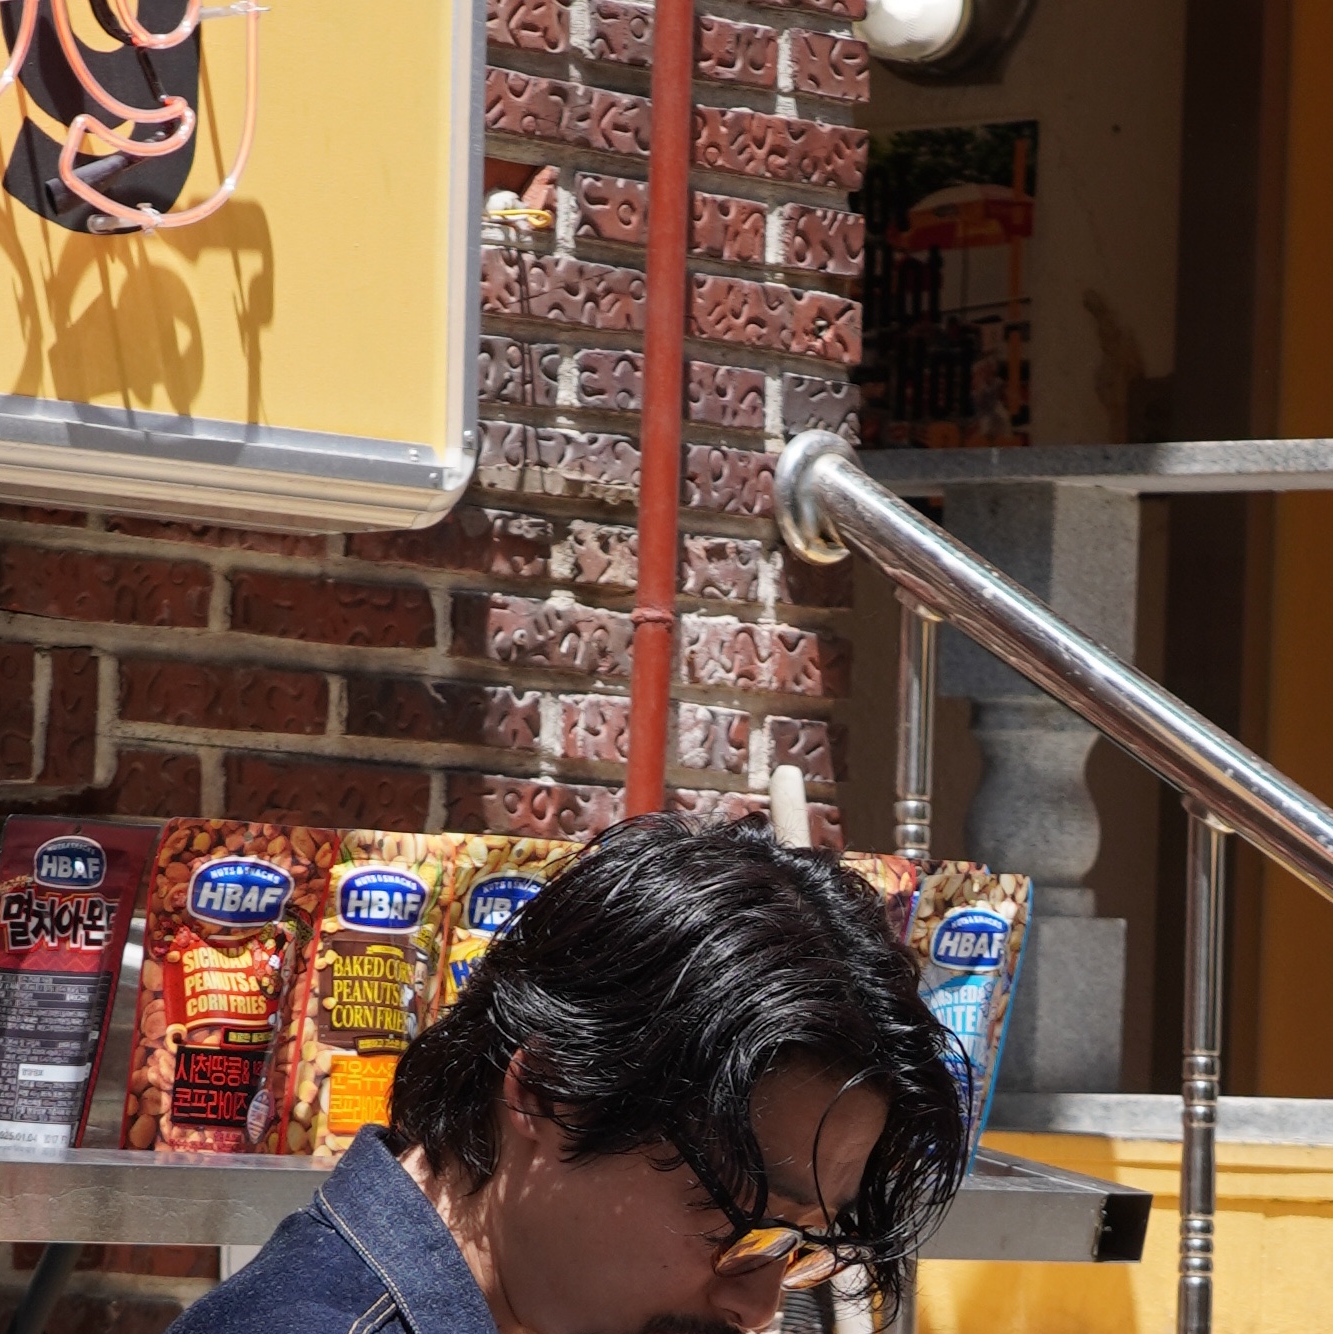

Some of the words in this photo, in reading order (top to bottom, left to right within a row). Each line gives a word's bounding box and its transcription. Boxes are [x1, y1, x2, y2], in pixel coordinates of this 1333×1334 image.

[40, 854, 100, 879] HBAF
[198, 882, 284, 914] HBAF
[346, 889, 422, 921] HBAF
[937, 931, 1005, 959] HBAF
[333, 955, 384, 978] BAKED
[185, 996, 228, 1017] CORN
[229, 995, 267, 1015] FRIES
[332, 1004, 375, 1028] CORN
